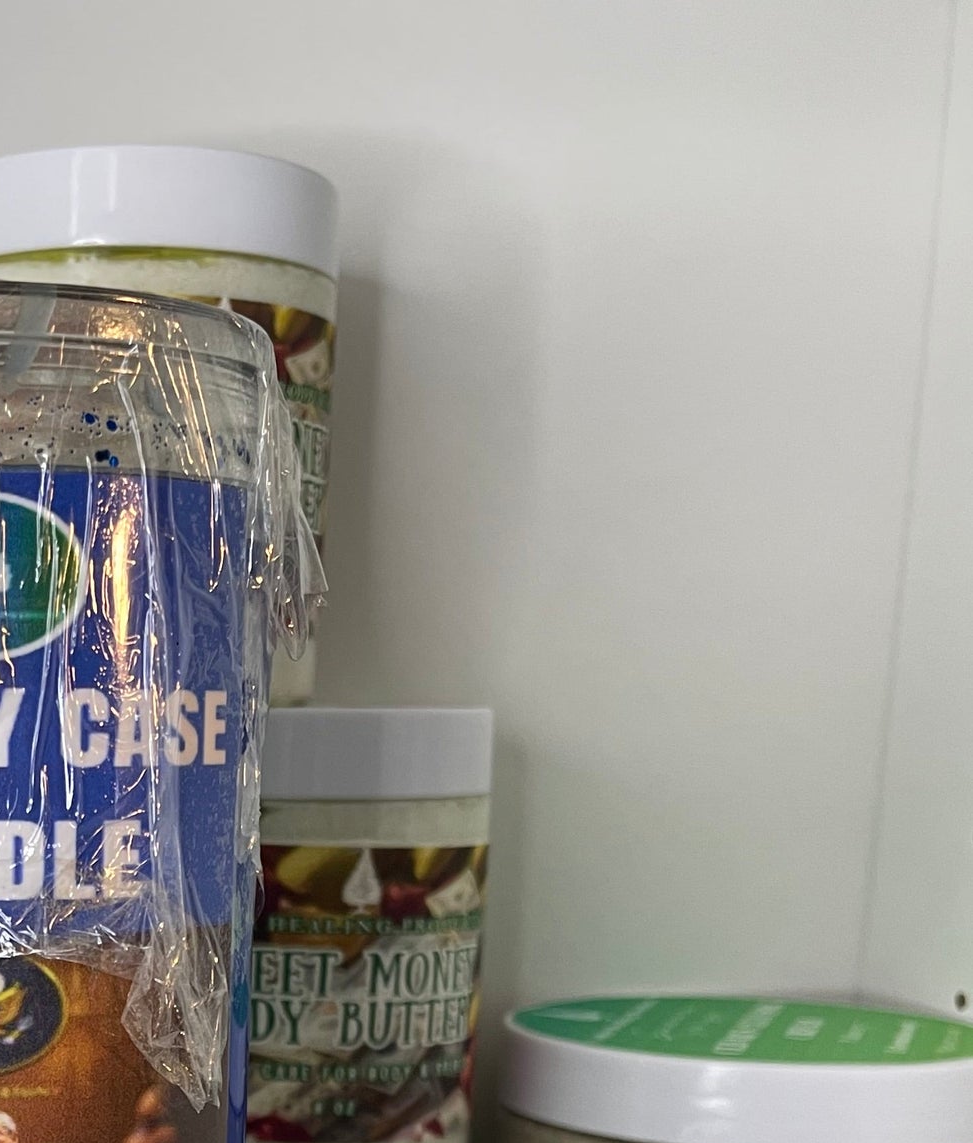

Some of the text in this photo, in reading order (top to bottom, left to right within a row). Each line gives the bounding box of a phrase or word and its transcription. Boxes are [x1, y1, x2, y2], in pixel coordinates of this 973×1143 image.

[60, 688, 226, 767] CASE
[251, 948, 339, 997] EET
[251, 999, 309, 1045] DY
